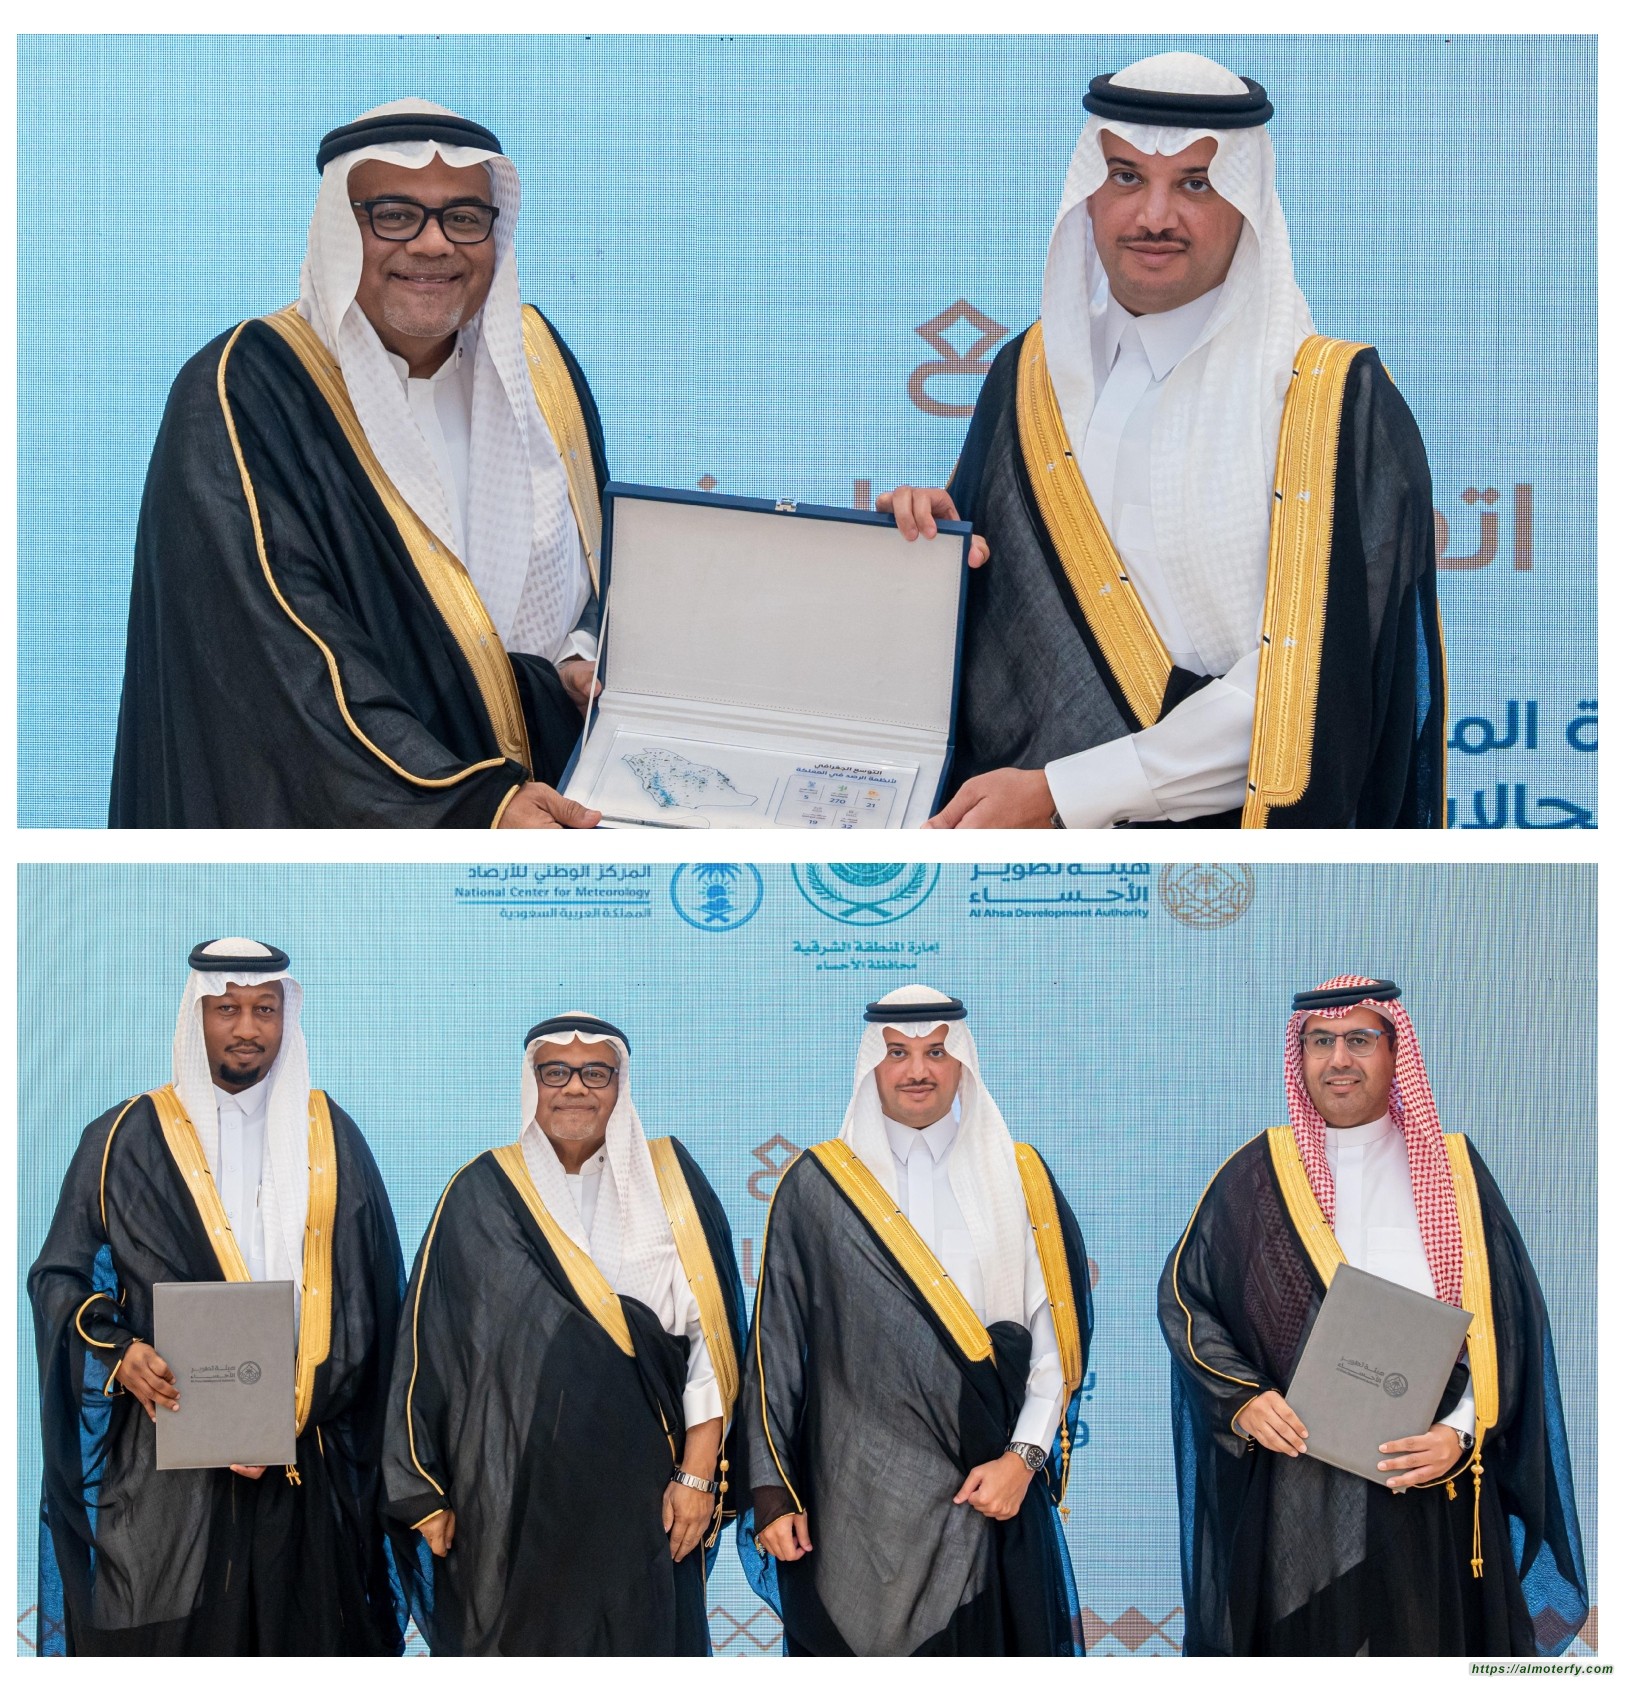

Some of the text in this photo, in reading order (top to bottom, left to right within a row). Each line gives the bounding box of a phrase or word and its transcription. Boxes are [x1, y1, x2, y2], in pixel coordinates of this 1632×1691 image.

[814, 763, 883, 776] التوسع الجغرافي
[534, 864, 590, 885] الوطني
[595, 863, 651, 882] المركز
[455, 887, 651, 900] National Center for Meteorology
[500, 907, 651, 920] المملكة العربية السعودية
[969, 908, 1149, 919] Al Ahsa Development Authority
[792, 940, 852, 956] الشرقية
[854, 941, 904, 953] المنطقة
[868, 959, 917, 970] محافظة
